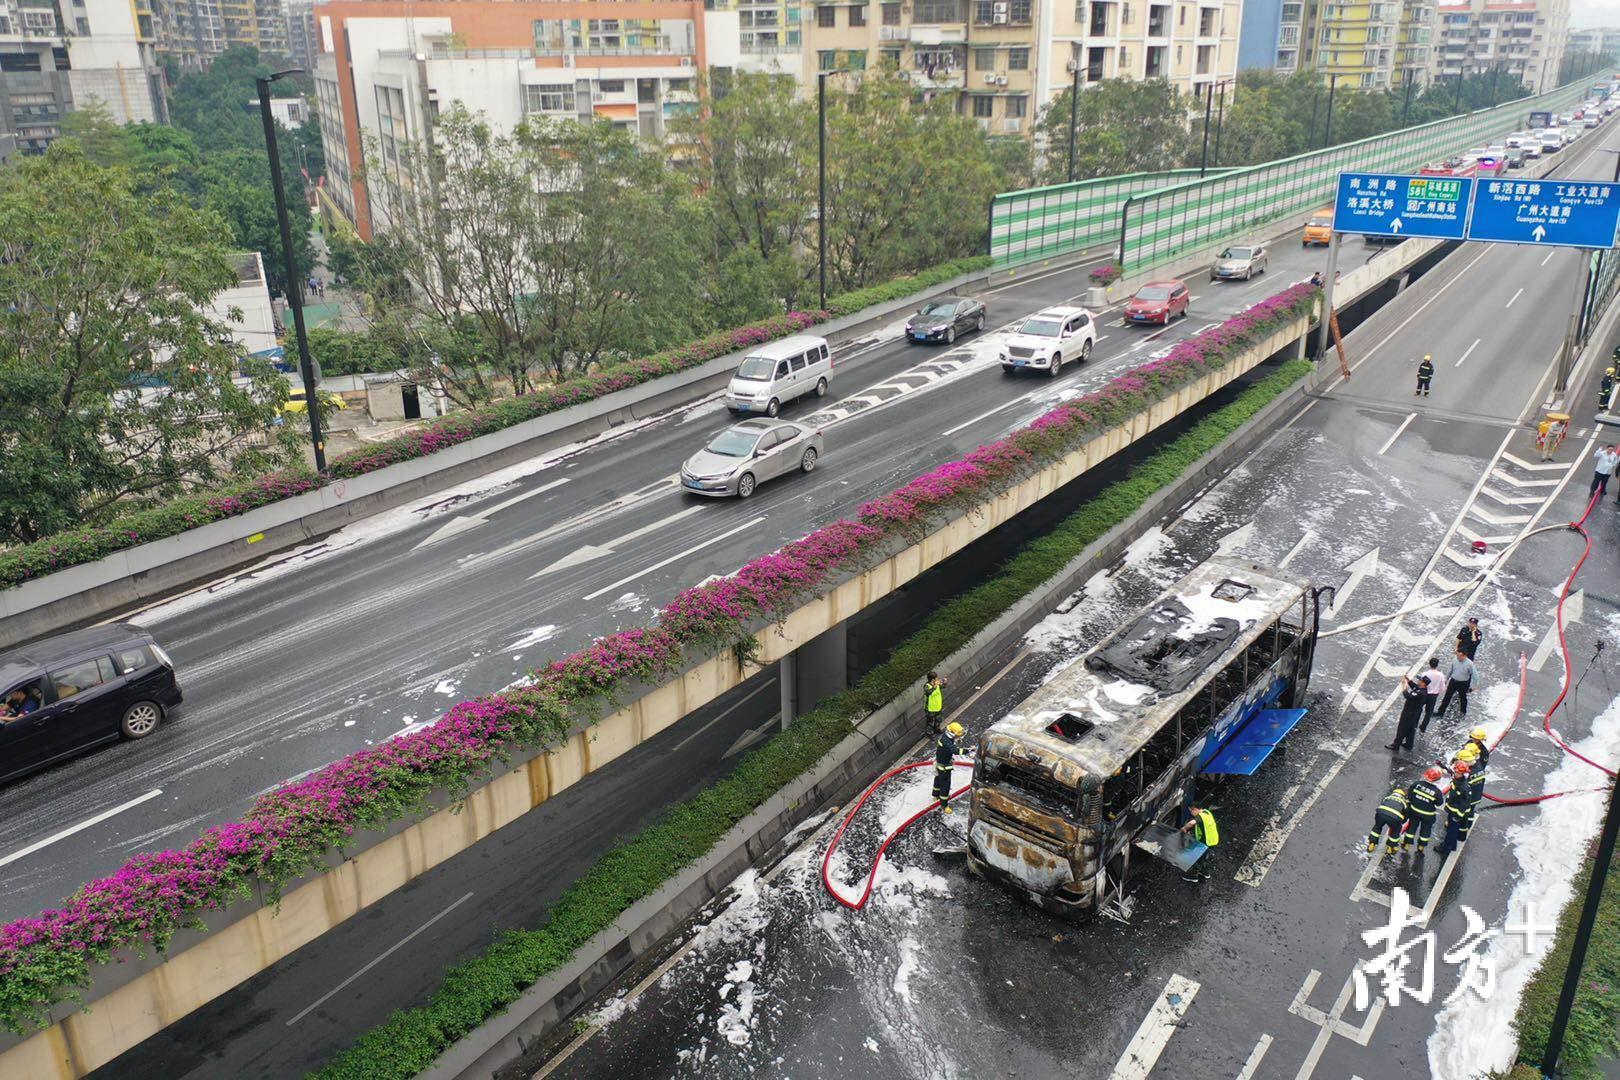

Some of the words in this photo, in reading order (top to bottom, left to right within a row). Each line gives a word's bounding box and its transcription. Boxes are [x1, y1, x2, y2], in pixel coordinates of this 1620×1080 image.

[1350, 178, 1397, 190] 南洲路
[1555, 185, 1611, 198] 工业大道南
[1347, 197, 1395, 210] 洛溪大桥
[1417, 200, 1457, 213] 广州南站
[1517, 204, 1572, 217] 广州大道南
